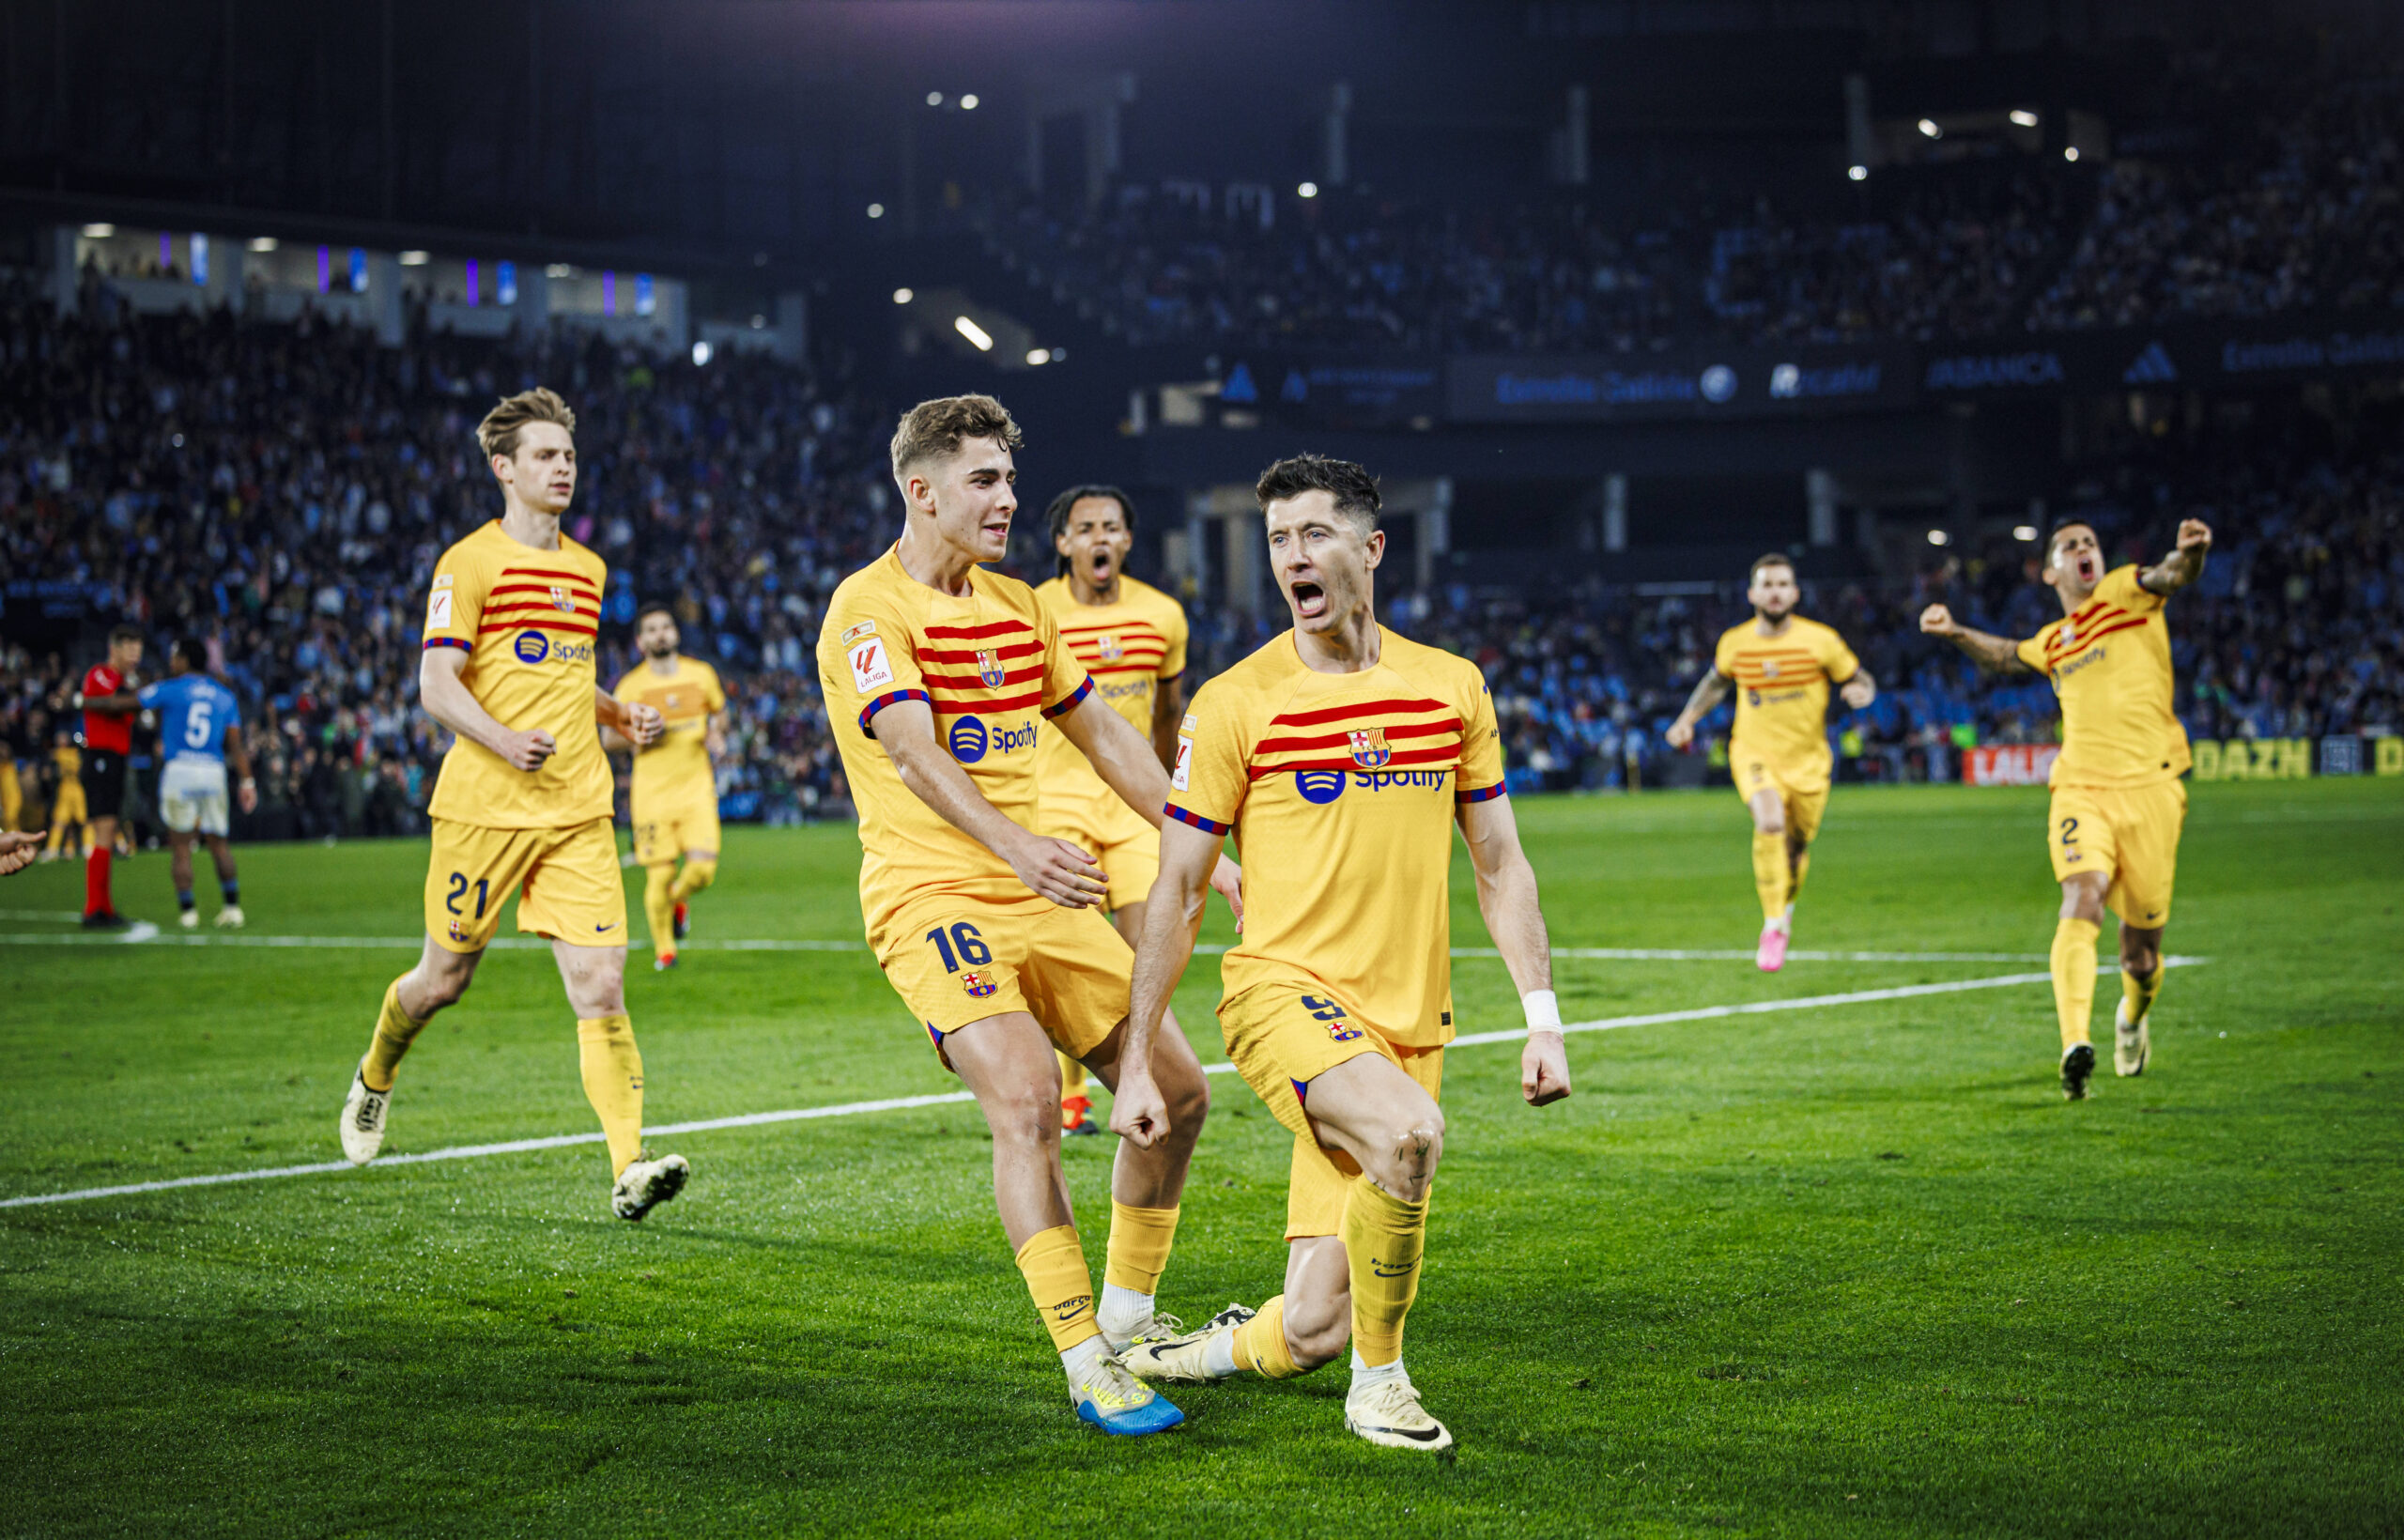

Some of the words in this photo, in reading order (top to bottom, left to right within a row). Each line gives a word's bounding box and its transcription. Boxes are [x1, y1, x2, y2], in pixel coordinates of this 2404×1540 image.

[860, 671, 887, 687] LALIGA
[184, 702, 212, 749] 5
[992, 721, 1038, 754] Spotify
[2192, 737, 2311, 781] DAZN
[2059, 817, 2078, 845] 2
[446, 871, 489, 919] 21
[925, 921, 993, 974] 16
